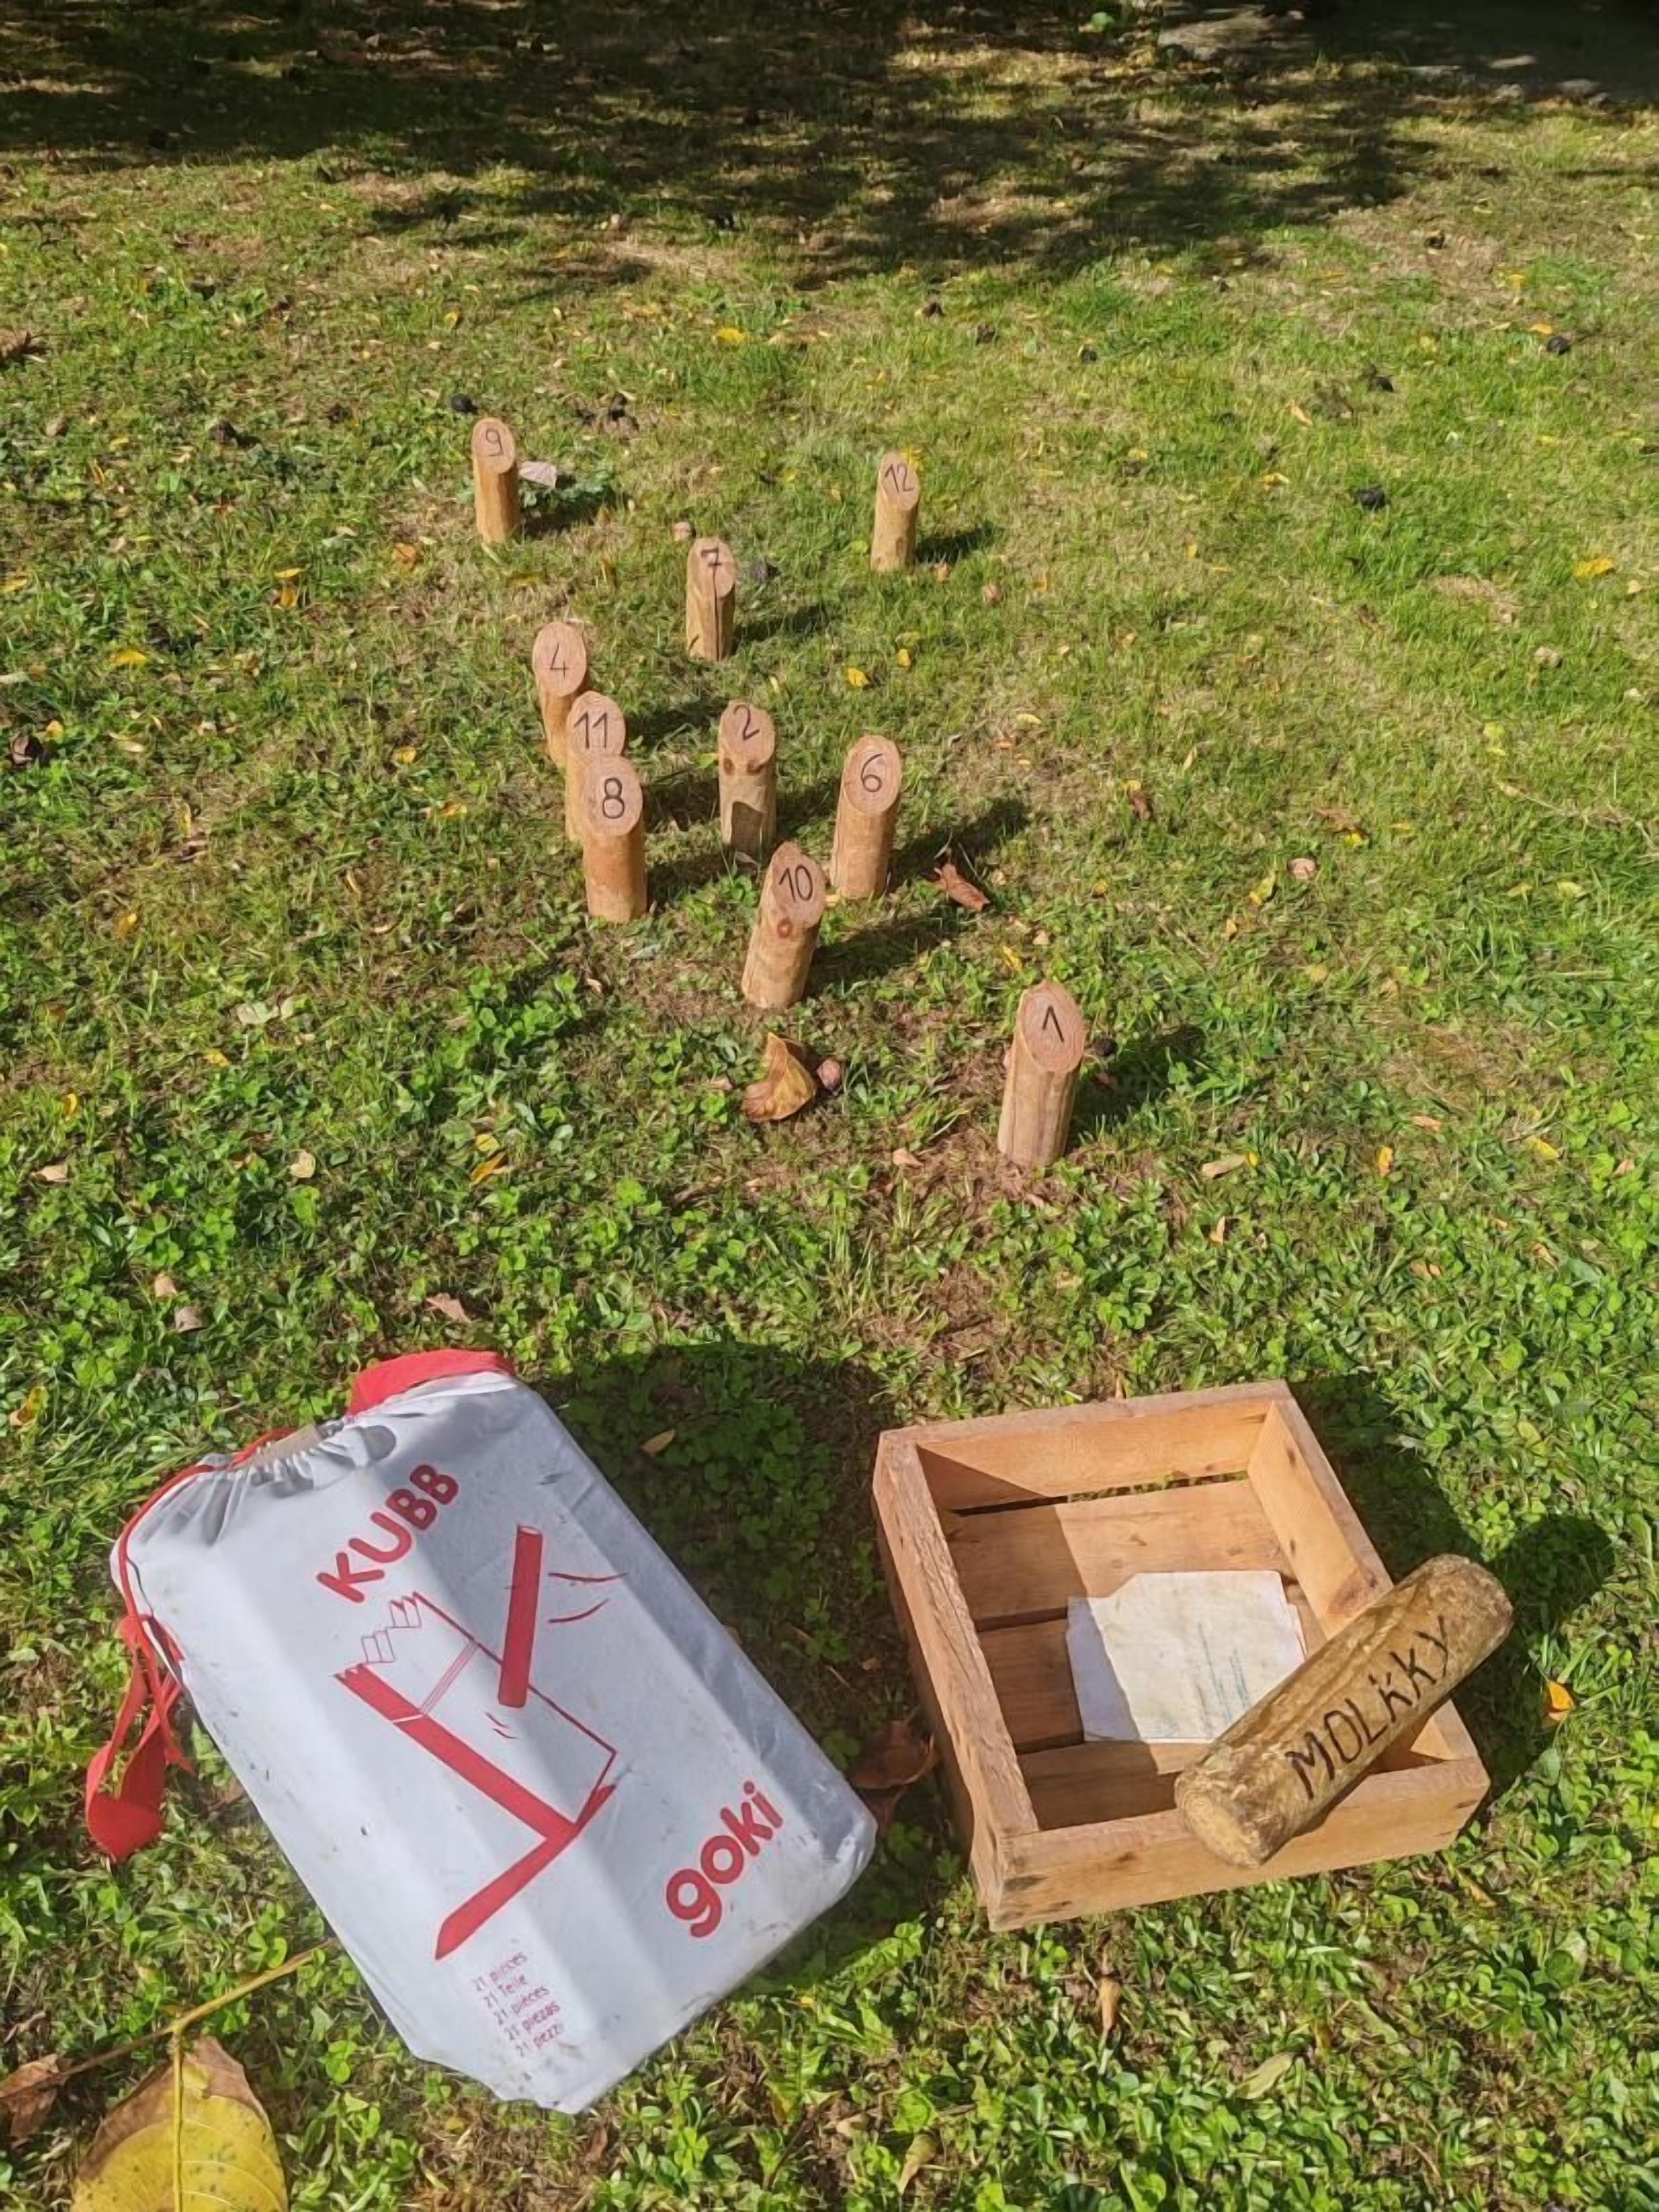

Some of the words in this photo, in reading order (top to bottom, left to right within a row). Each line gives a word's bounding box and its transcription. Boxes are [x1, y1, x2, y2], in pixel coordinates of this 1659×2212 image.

[485, 428, 503, 457] 9
[884, 463, 916, 493] 12
[701, 543, 721, 579] 7
[549, 642, 569, 678] 4
[573, 712, 608, 749] 11
[733, 704, 760, 741] 2
[860, 753, 883, 793] 6
[601, 777, 625, 819] 8
[778, 864, 814, 902] 10
[1041, 1005, 1065, 1043] 1
[316, 1464, 459, 1604] KUBB
[666, 1780, 783, 1938] goki
